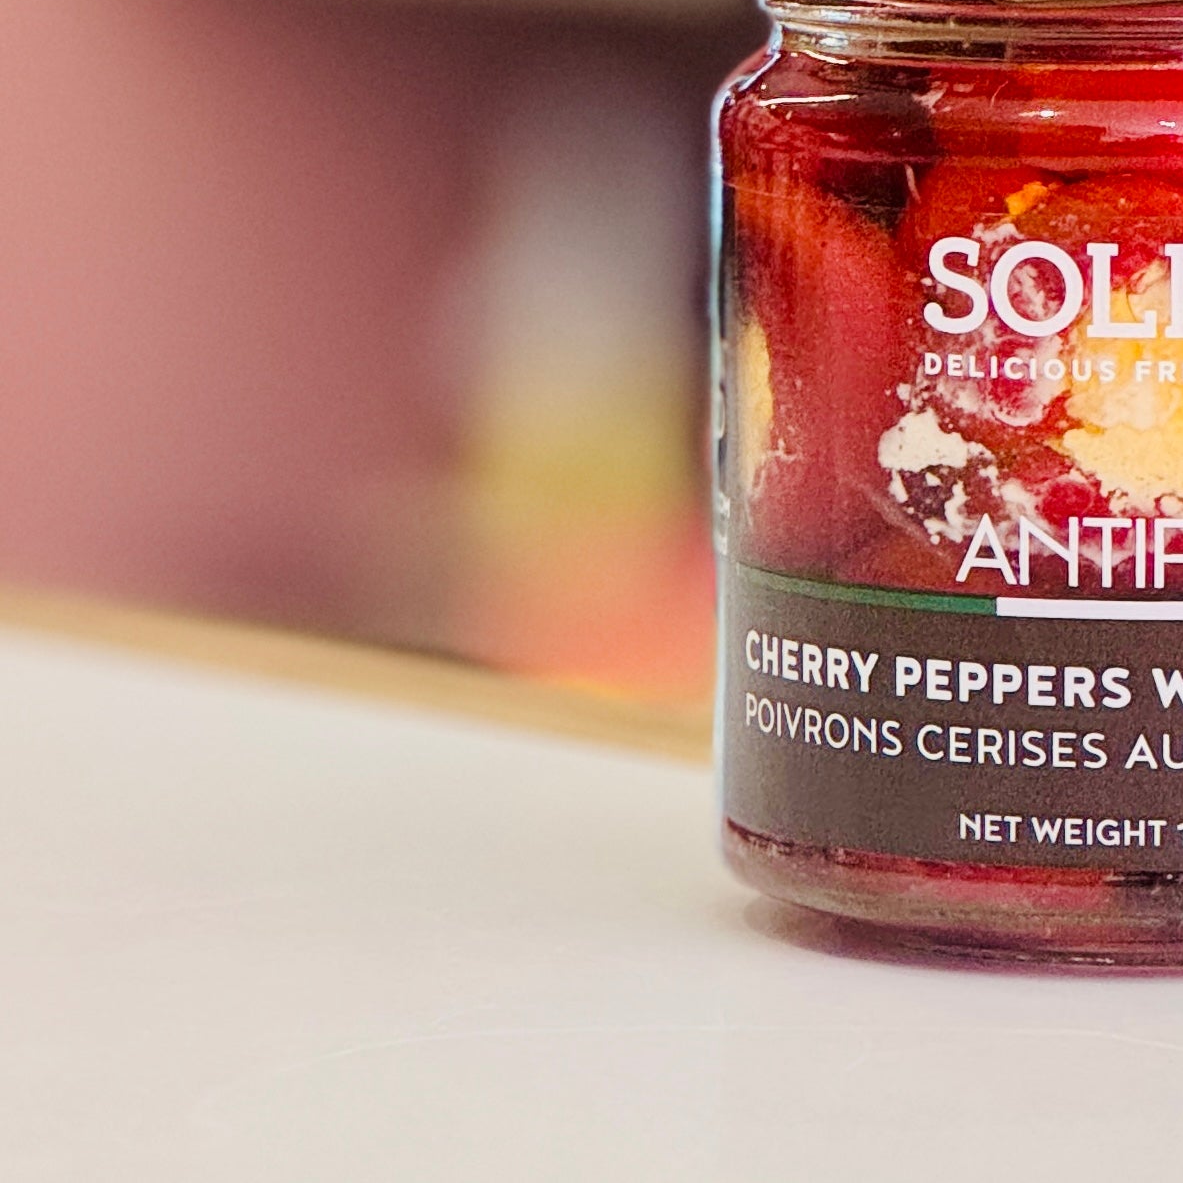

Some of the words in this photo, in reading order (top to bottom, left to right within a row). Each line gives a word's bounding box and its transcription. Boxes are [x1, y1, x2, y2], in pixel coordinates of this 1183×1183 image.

[924, 353, 1116, 383] DELICIOUS
[745, 629, 879, 693] CHERRY
[895, 655, 1131, 709] PEPPERS
[744, 692, 902, 757] POIVRONS
[917, 724, 1107, 769] CERISES
[959, 813, 1022, 843] NET
[1031, 817, 1167, 847] WEIGHT
